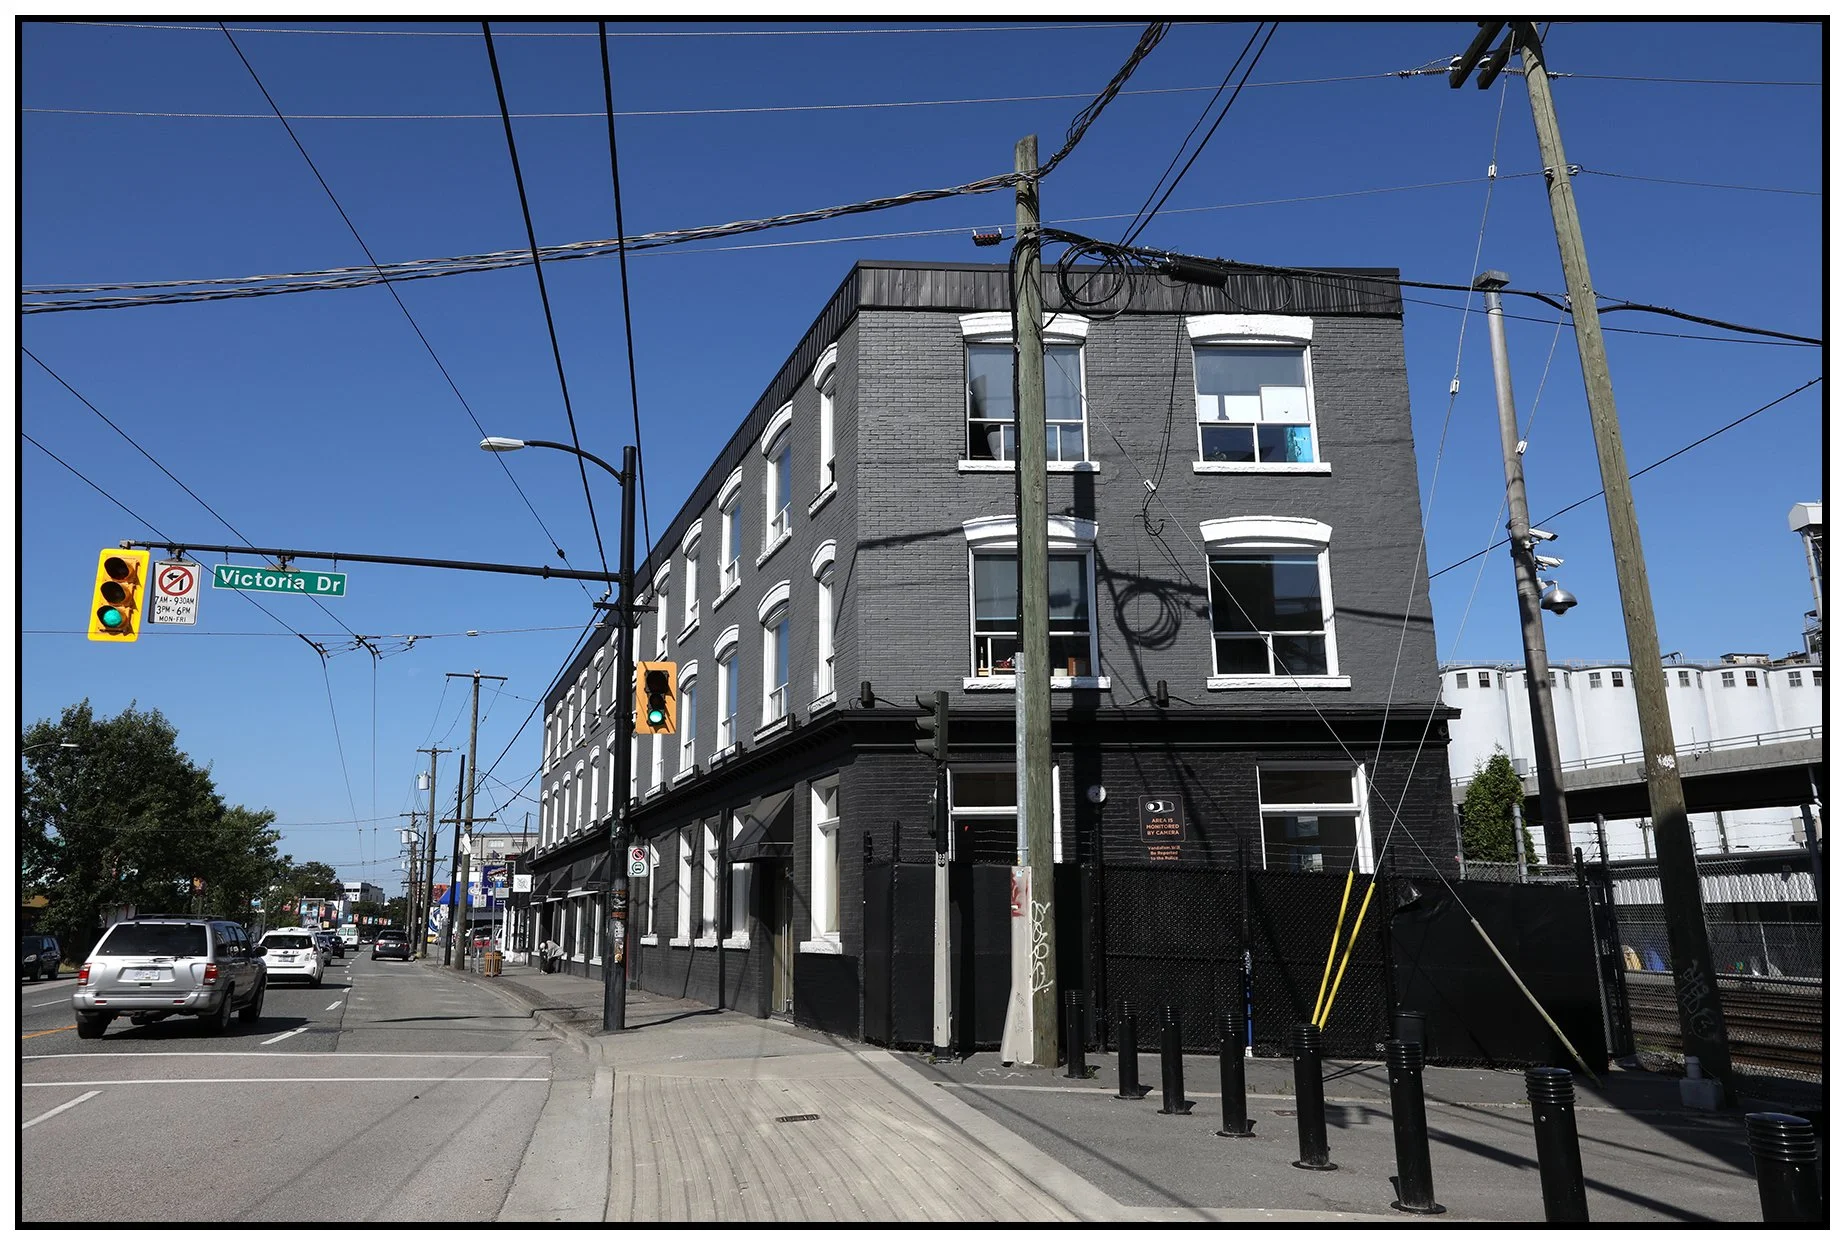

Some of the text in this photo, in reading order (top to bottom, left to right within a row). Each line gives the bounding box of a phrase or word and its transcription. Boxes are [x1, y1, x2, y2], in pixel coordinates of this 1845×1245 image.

[220, 568, 341, 592] Victoria Dr
[154, 595, 168, 605] 7AM
[156, 605, 171, 615] 3PM
[176, 606, 191, 616] 6PM
